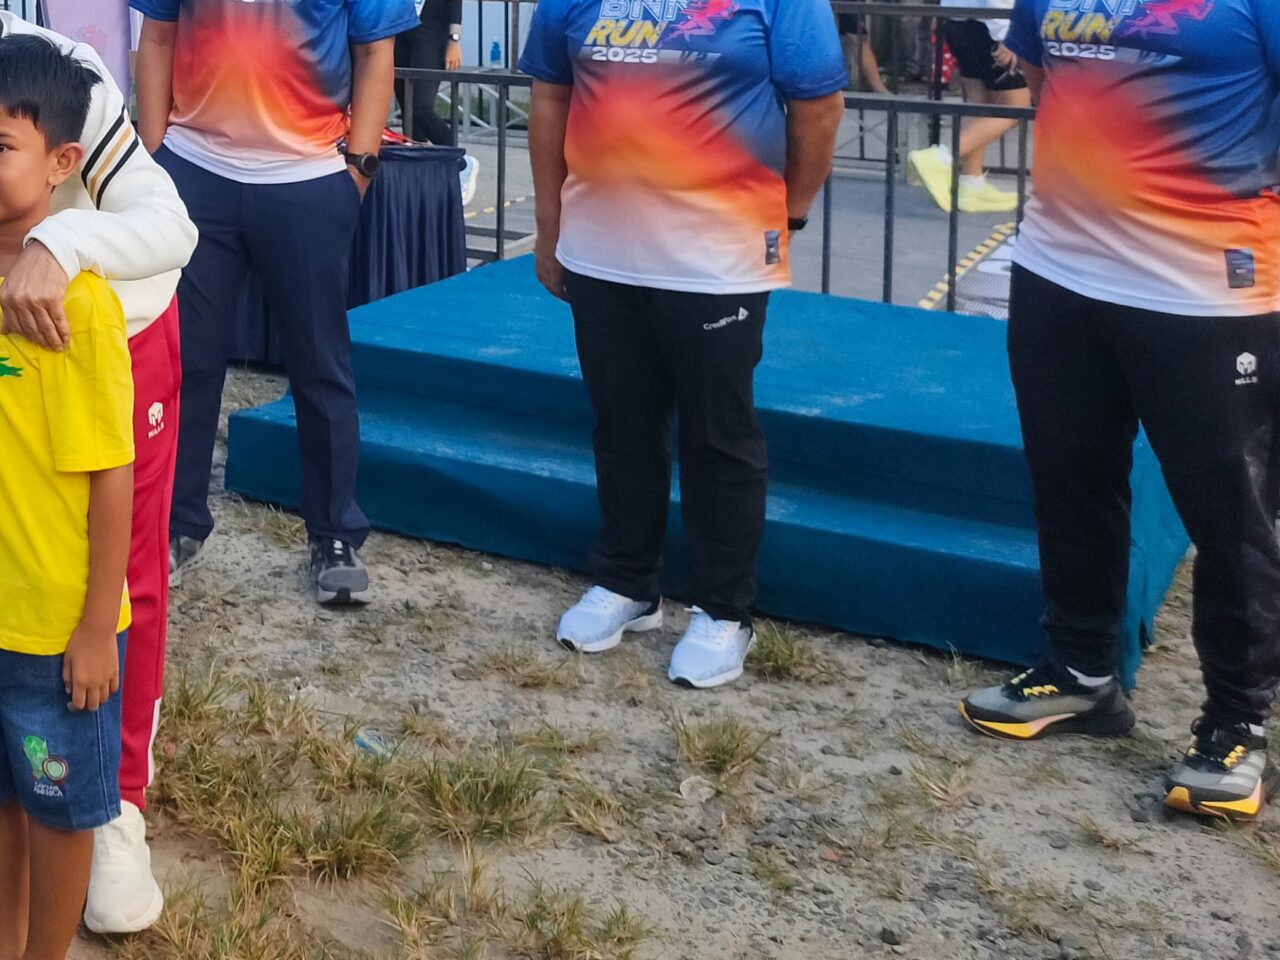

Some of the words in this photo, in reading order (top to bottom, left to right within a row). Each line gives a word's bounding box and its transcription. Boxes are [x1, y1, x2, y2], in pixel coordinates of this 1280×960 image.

[584, 19, 669, 49] RUN
[1040, 10, 1124, 44] RUN
[592, 46, 658, 64] 2025
[1047, 41, 1116, 61] 2025
